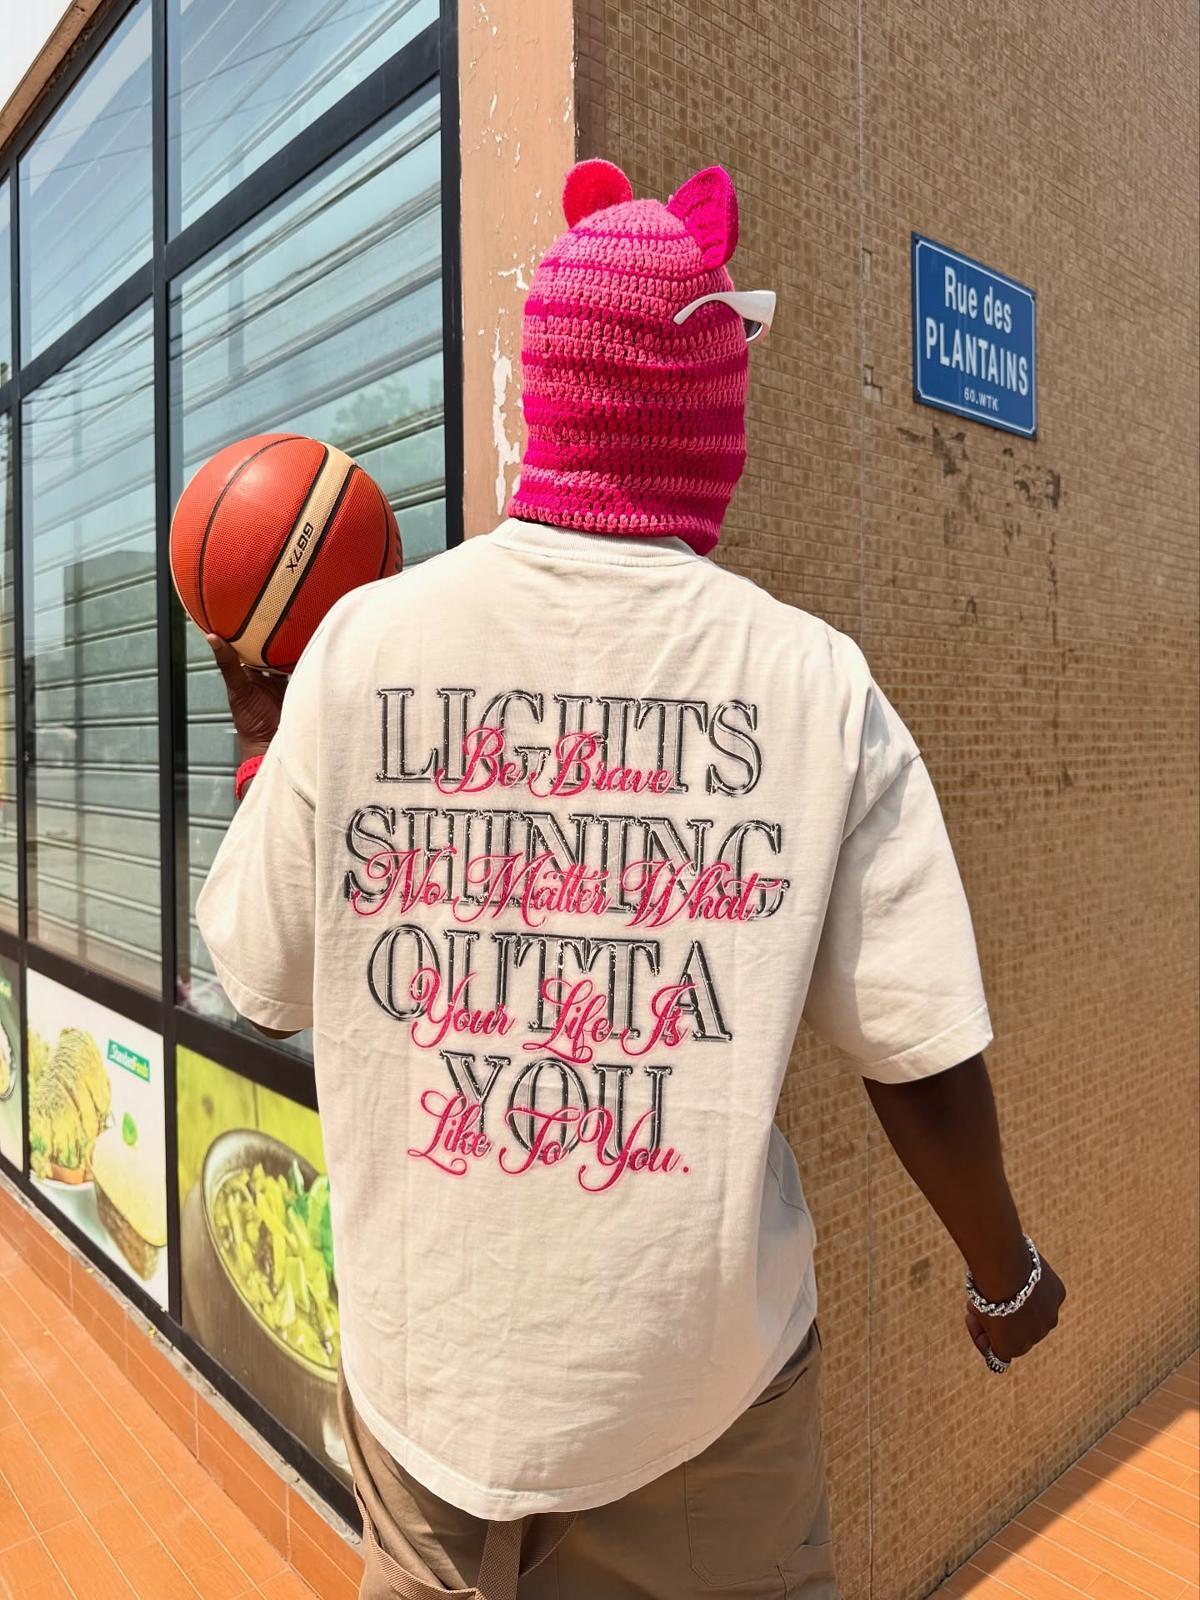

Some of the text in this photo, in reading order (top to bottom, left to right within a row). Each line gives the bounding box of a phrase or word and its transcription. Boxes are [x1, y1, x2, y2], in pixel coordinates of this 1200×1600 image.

[944, 265, 1012, 334] Rue des
[925, 316, 1029, 397] PLANTAINS
[286, 522, 314, 573] GG7X
[375, 687, 763, 797] LIGHTS
[434, 726, 675, 798] Be Brave
[344, 804, 790, 921] SHINING
[351, 846, 457, 918] No
[620, 859, 784, 929] What
[366, 924, 734, 1043] OUTTA
[410, 966, 699, 1065] Your Life Is
[407, 1088, 691, 1193] Like To You.
[438, 1049, 674, 1160] YOU
